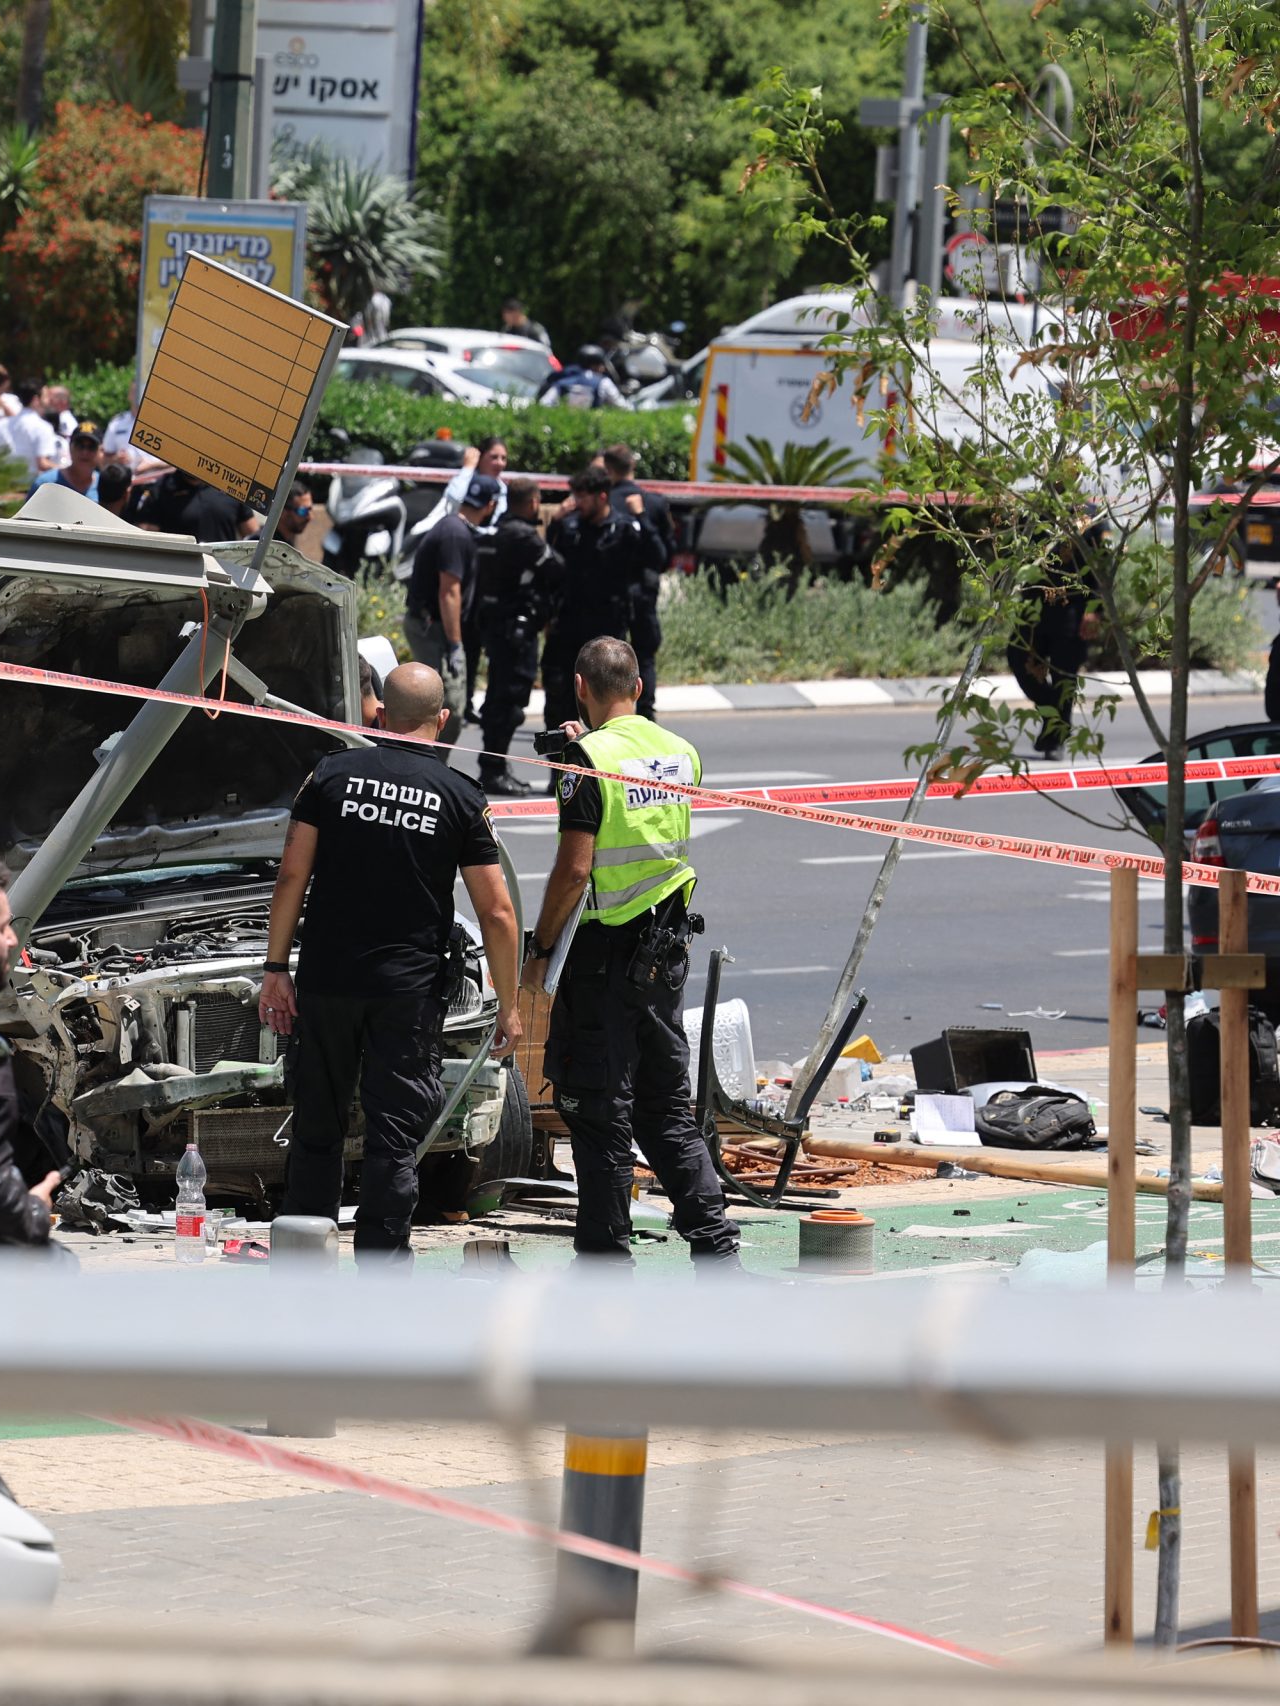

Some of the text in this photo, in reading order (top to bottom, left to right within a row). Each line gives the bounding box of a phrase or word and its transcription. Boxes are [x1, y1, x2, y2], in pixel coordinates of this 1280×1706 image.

[310, 76, 379, 102] אסקו
[166, 231, 272, 260] מדיזנגוף
[135, 429, 163, 451] 425
[196, 456, 250, 491] ראשון לציון
[346, 777, 441, 812] משטרה
[833, 788, 864, 799] ישראל
[879, 785, 914, 797] משטרת
[727, 797, 778, 815] משטרת
[341, 800, 438, 835] POLICE
[799, 809, 974, 847] משטרת ישראל אין מעבר
[996, 838, 1031, 855] מעבר
[1033, 844, 1052, 860] אין
[1054, 845, 1096, 864] ישראל
[1193, 868, 1221, 884] עבר
